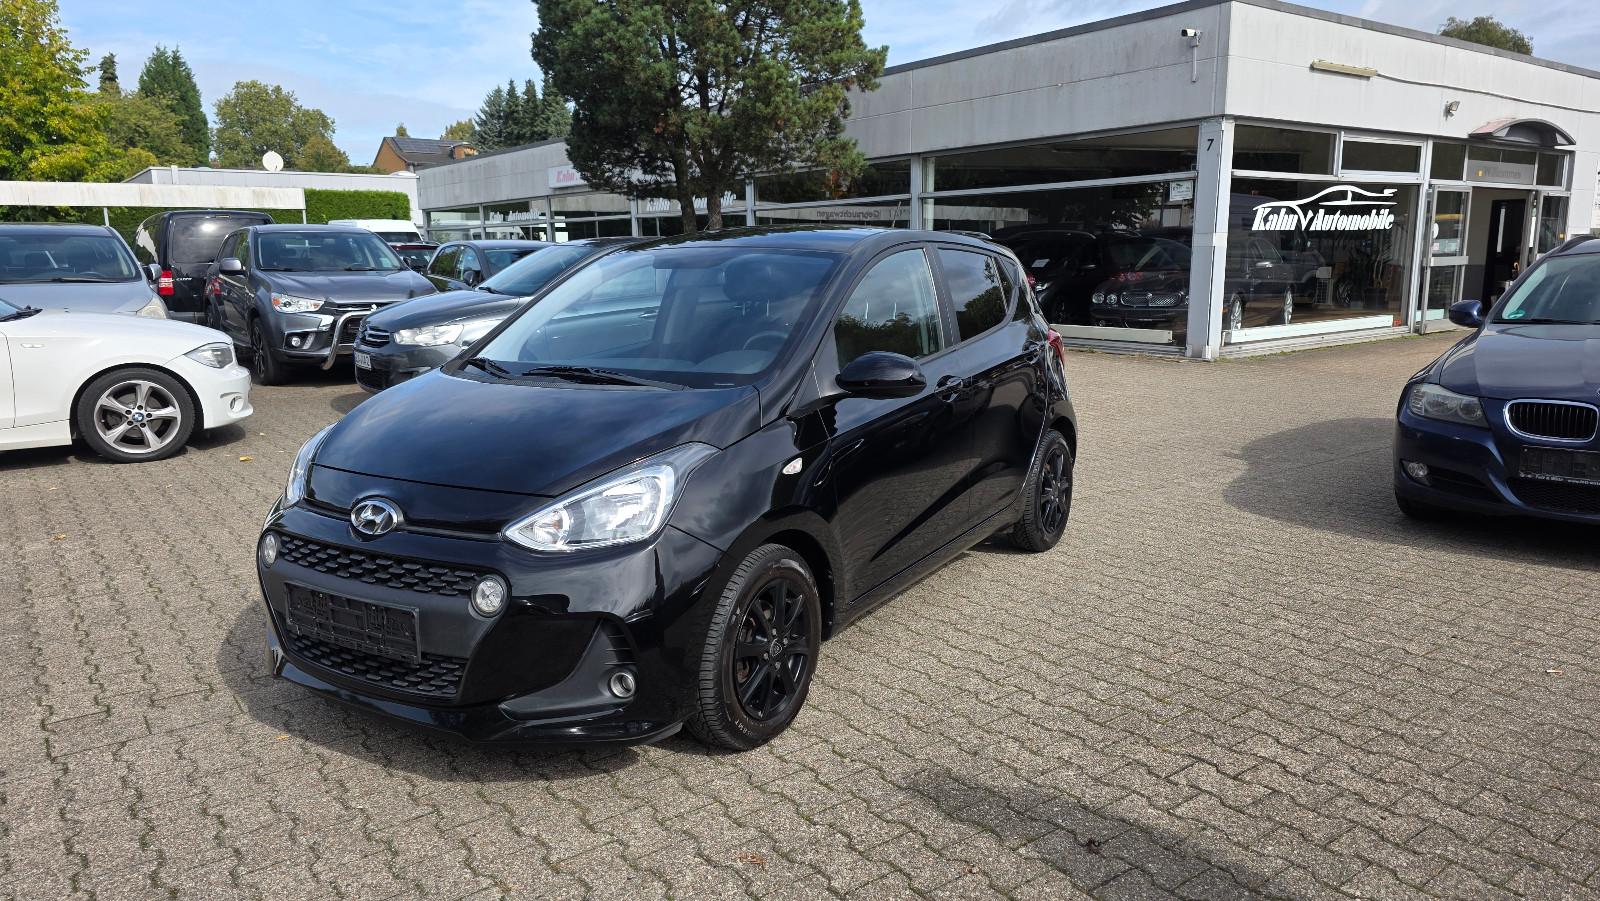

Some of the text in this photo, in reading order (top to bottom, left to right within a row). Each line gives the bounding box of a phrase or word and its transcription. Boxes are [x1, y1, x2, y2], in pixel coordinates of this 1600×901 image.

[1206, 138, 1215, 152] 7
[1251, 207, 1395, 231] Kahn Automobile
